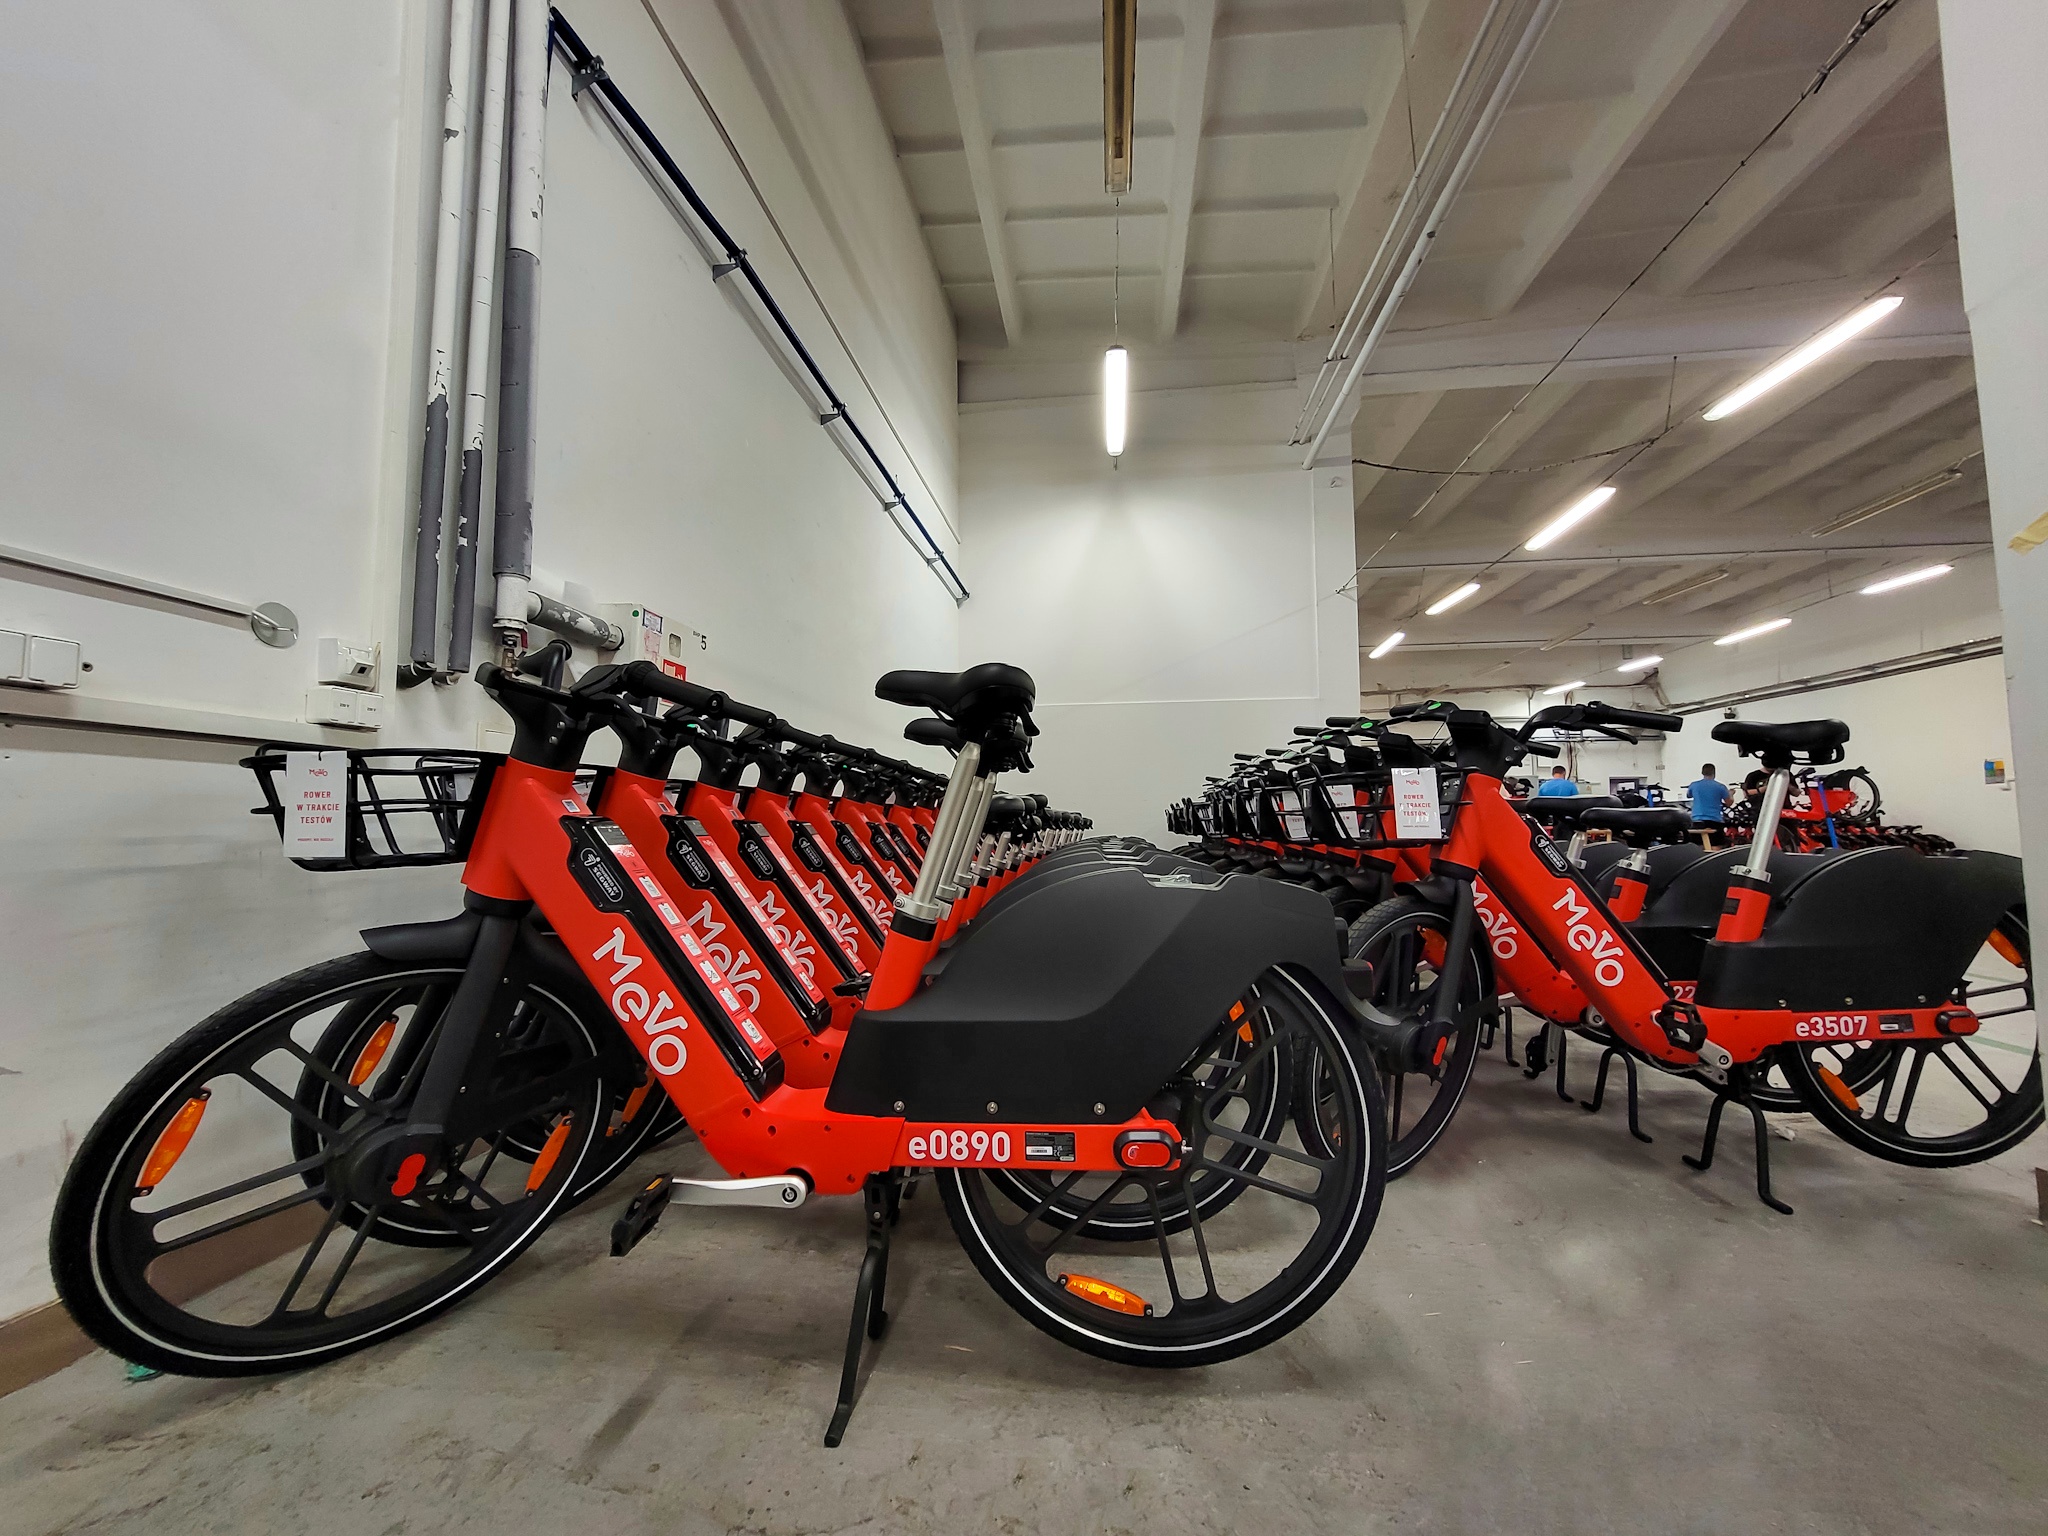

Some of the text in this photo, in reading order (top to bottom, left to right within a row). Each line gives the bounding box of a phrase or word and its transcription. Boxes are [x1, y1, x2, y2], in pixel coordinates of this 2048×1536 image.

[700, 634, 707, 650] 5
[306, 803, 340, 811] TRAKCIE
[300, 815, 333, 824] TESTÓW
[592, 866, 616, 896] SEGWAY
[1795, 1015, 1868, 1037] e3507
[908, 1129, 1011, 1162] e0890
